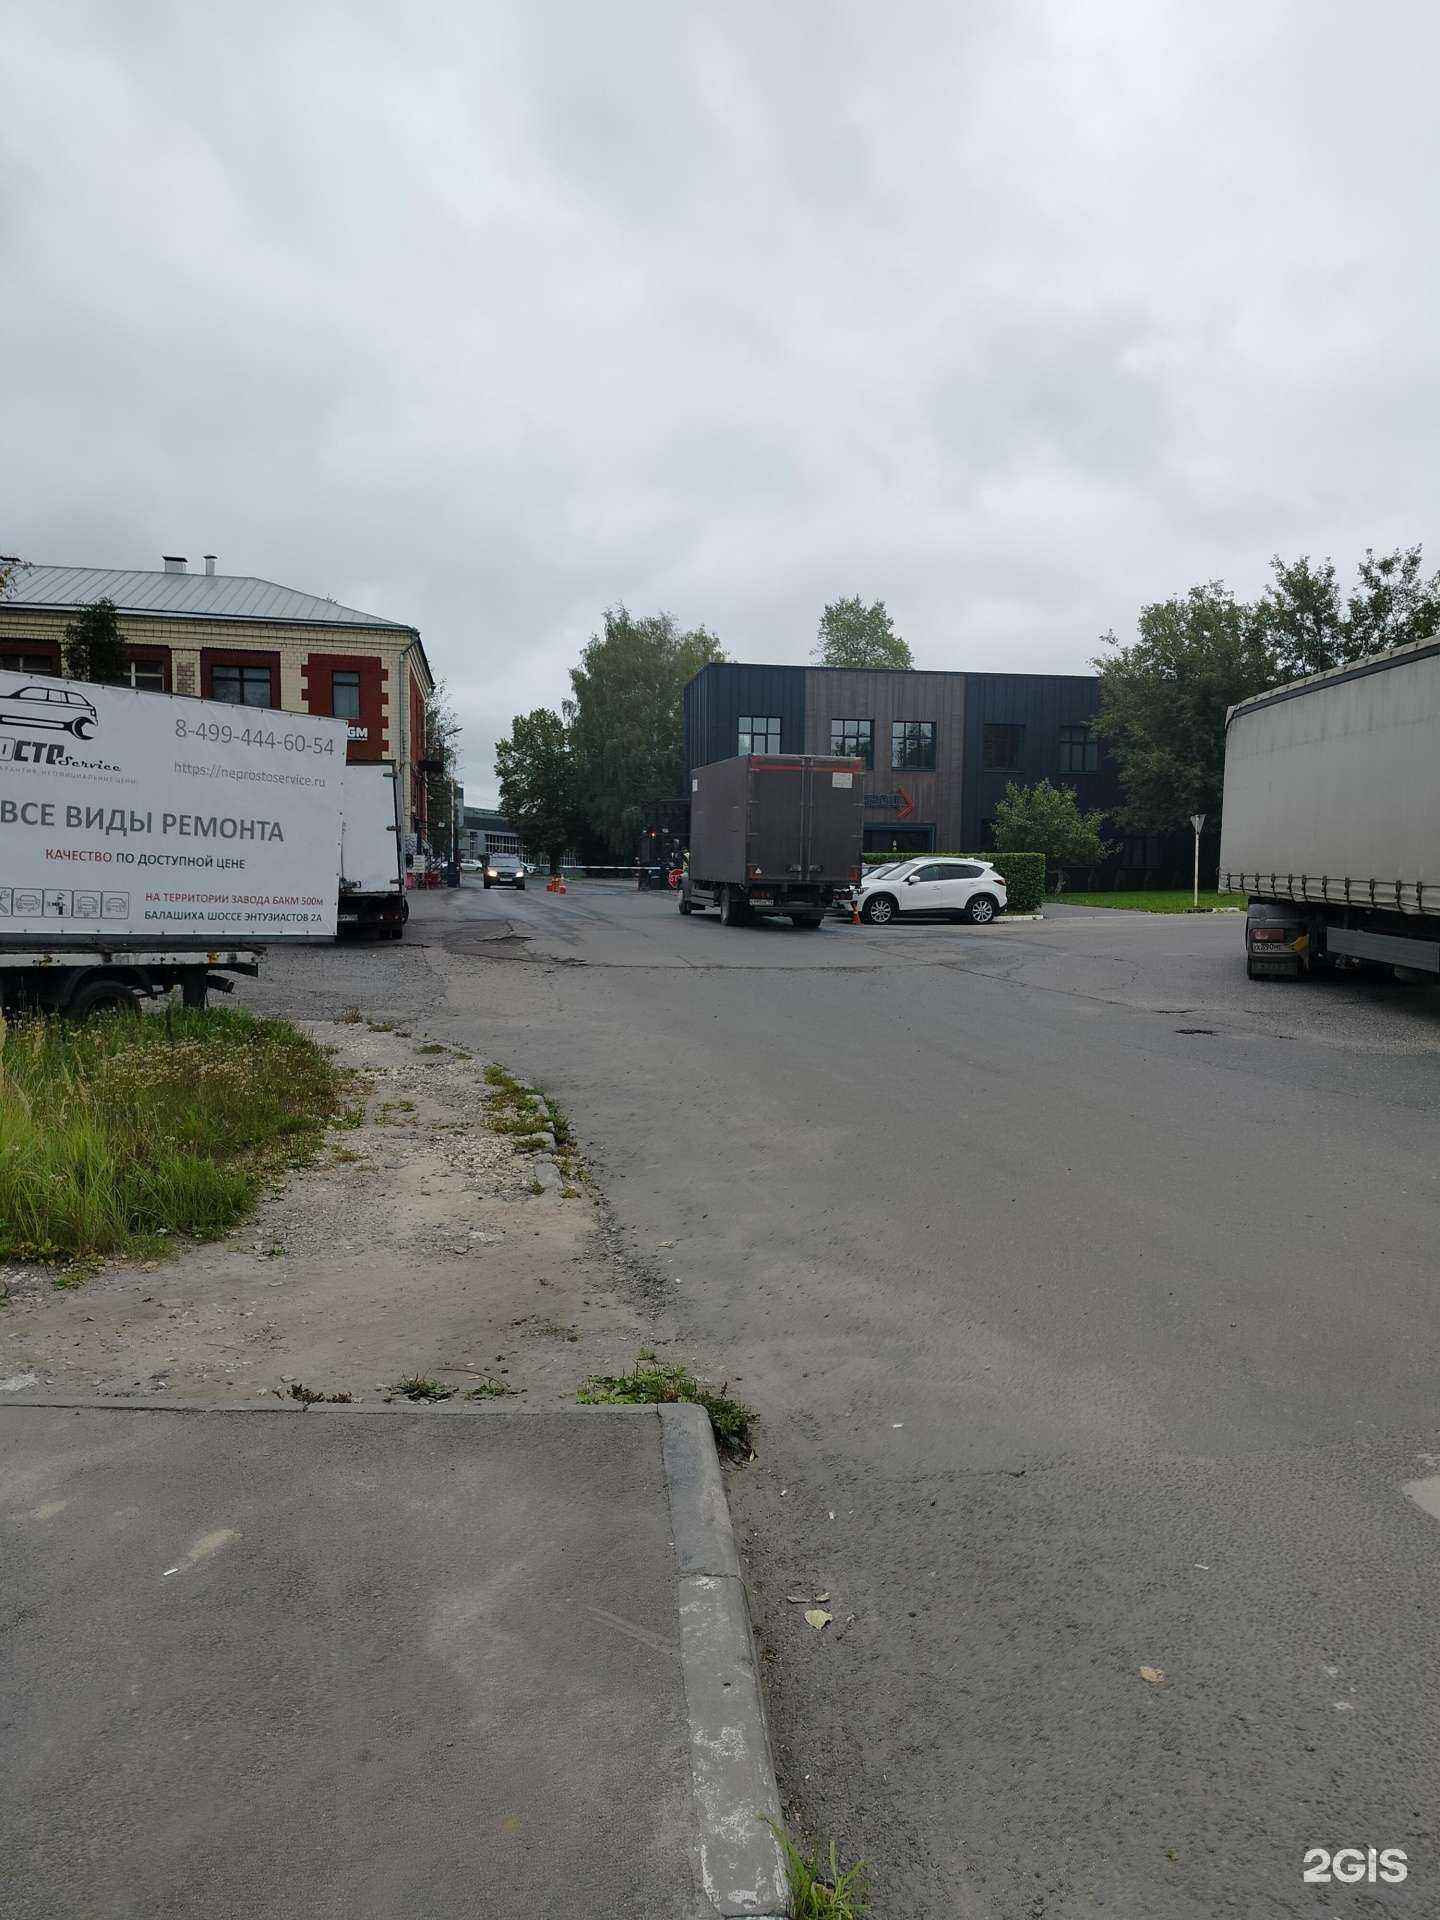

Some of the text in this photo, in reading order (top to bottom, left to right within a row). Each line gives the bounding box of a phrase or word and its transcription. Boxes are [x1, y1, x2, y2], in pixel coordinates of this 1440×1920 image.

[175, 719, 334, 756] 8-499-444-60-54
[58, 756, 121, 772] Service
[174, 760, 326, 788] https://neprostoservice.ru
[0, 800, 285, 842] ВСЕ ВИДЫ РЕМОНТА
[46, 849, 246, 870] КАЧЕСТВО ПО ДОСТУПНОЙ ЦЕНЕ
[145, 892, 161, 902] НА
[163, 893, 229, 904] ТЕРРИТОРИИ
[231, 895, 270, 906] ЗАВОДА
[144, 910, 322, 922] БАЛАШИХА ШОССЕ ЭНТУЗИАСТОВ 2А
